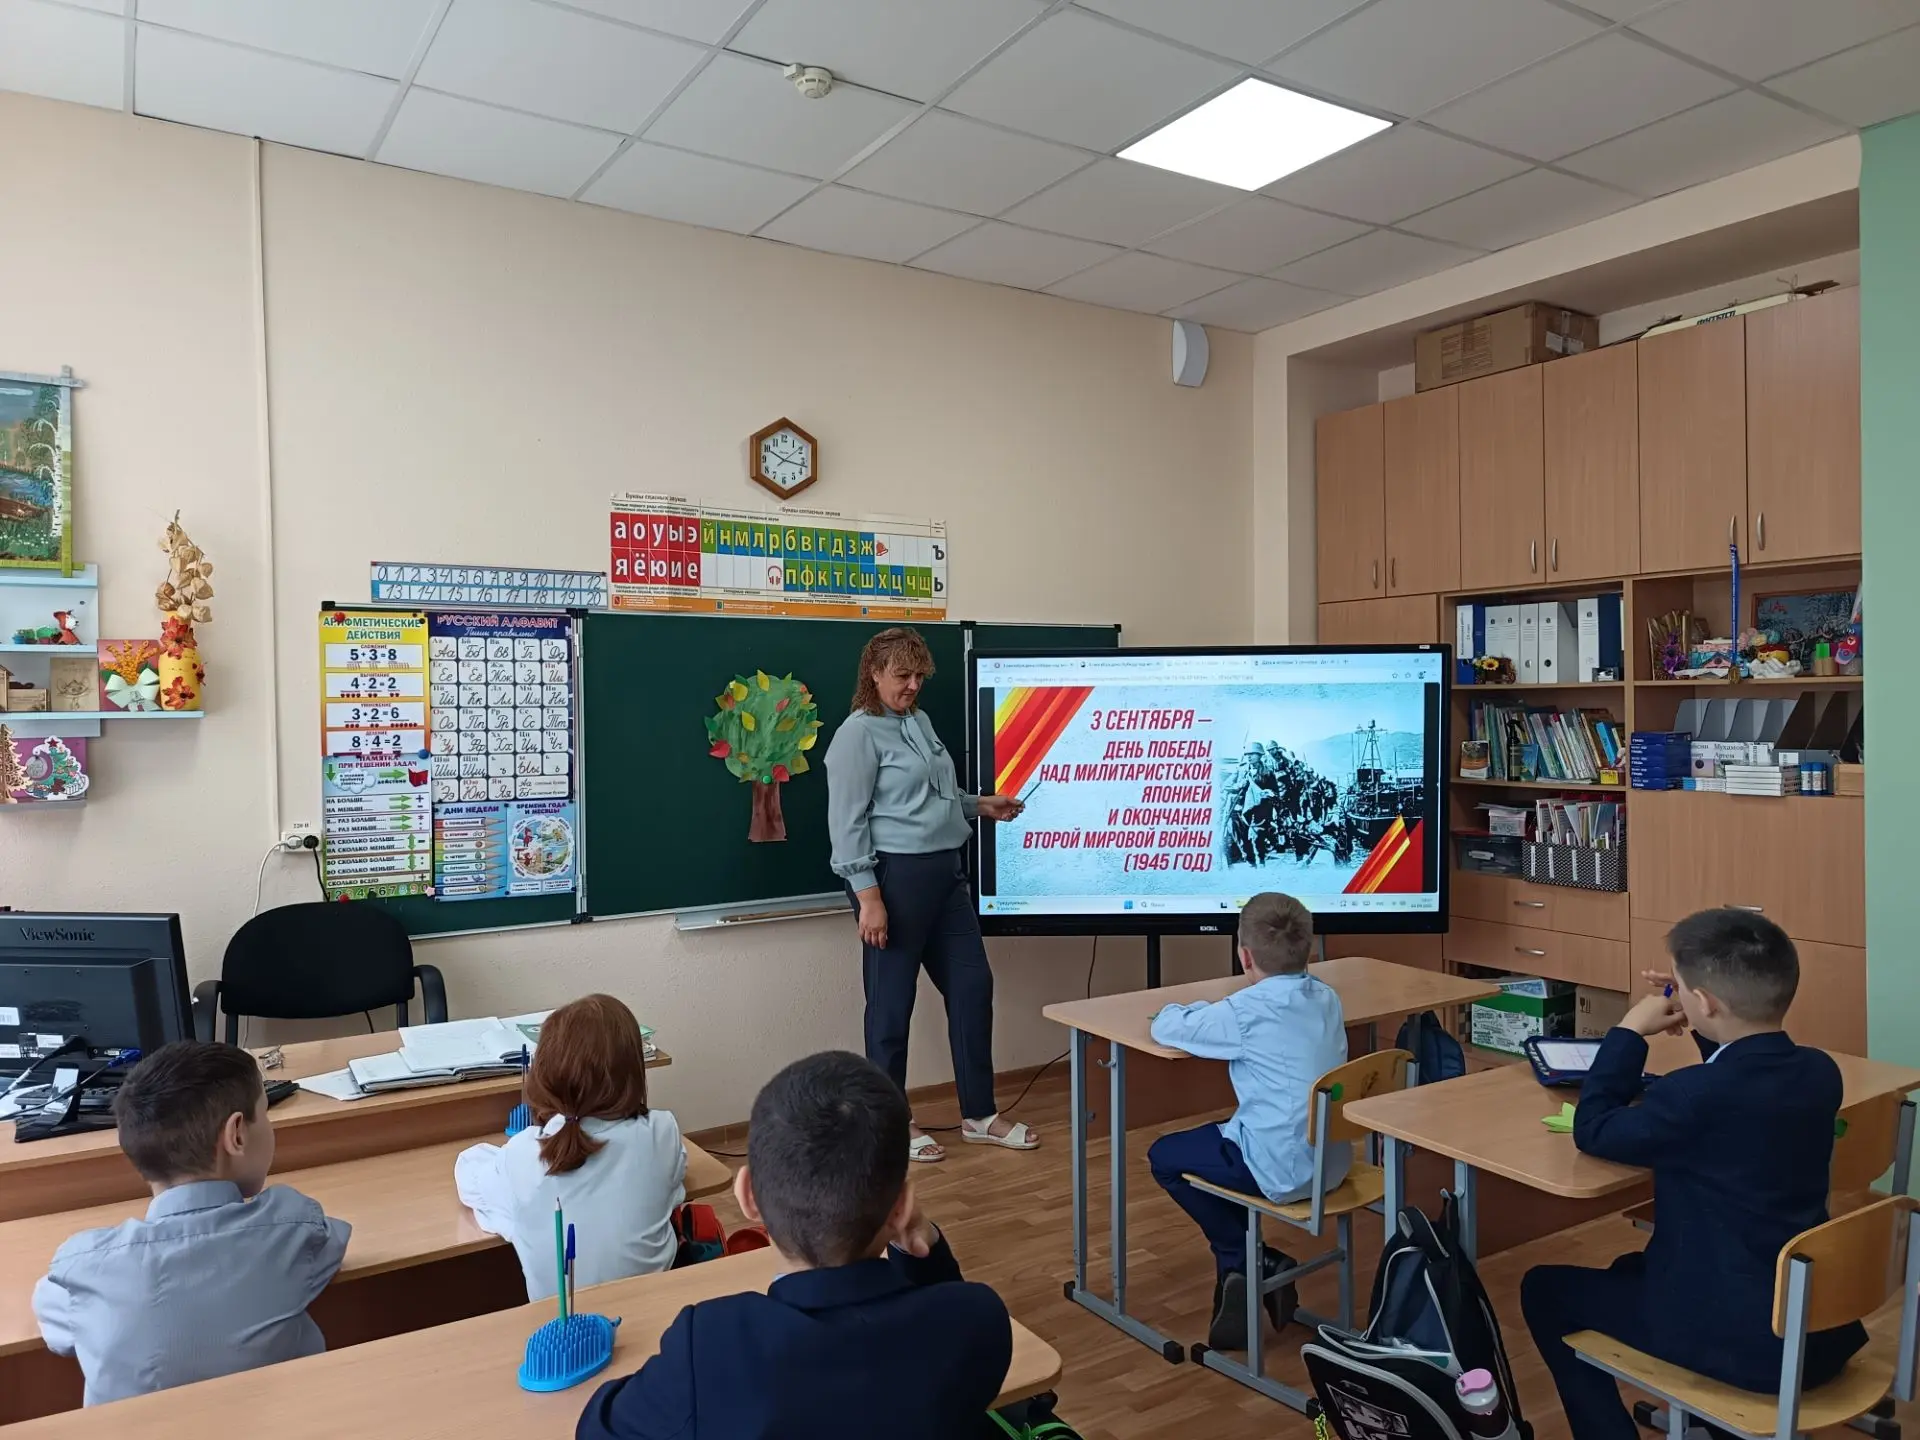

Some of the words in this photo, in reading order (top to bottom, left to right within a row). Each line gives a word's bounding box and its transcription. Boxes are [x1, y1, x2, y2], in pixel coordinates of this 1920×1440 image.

[772, 438, 779, 447] 11
[781, 434, 788, 443] 12
[764, 444, 771, 453] 10
[378, 566, 387, 581] 0
[394, 566, 404, 582] 1
[409, 566, 420, 583] 2
[426, 567, 436, 583] 3
[439, 568, 450, 584] 4
[457, 569, 467, 584] 5
[473, 570, 482, 585] 6
[489, 571, 498, 585] 7
[504, 571, 513, 586] 8
[520, 572, 528, 586] 9
[534, 573, 548, 587] 10
[560, 574, 574, 588] 11
[587, 575, 601, 590] 12
[386, 584, 401, 600] 13
[418, 585, 434, 600] 14
[447, 586, 463, 602] 15
[477, 587, 493, 602] 16
[506, 588, 520, 603] 17
[533, 589, 547, 604] 18
[560, 590, 576, 605] 19
[586, 591, 601, 606] 20
[437, 614, 498, 627] РУССКИЙ
[501, 617, 558, 628] АЛФАВИТ
[347, 629, 401, 640] ДЕЙСТВИЯ
[464, 627, 490, 637] Пиши
[1090, 710, 1101, 731] 3
[1105, 710, 1194, 730] СЕНТЯБРЯ
[360, 754, 399, 762] ПАМЯТКА
[1103, 741, 1143, 761] ДЕНЬ
[1147, 740, 1212, 761] ПОБЕДЫ
[1039, 764, 1071, 783] НАД
[1074, 760, 1212, 782] МИЛИТАРИСТСКОЙ
[1141, 782, 1212, 803] ЯПОНИЕЙ
[444, 807, 463, 815] ДНИ
[1108, 809, 1119, 826] И
[1122, 808, 1212, 826] ОКОНЧАНИЯ
[1023, 827, 1081, 849] ВТОРОЙ
[1083, 827, 1155, 849] МИРОВОЙ
[1158, 827, 1213, 848] ВОЙНЫ
[1124, 853, 1169, 872] (1945
[1173, 853, 1212, 872] ГОД)
[357, 889, 364, 897] 4
[379, 887, 386, 896] 6
[389, 886, 396, 894] 7
[20, 927, 95, 942] ViewSonic
